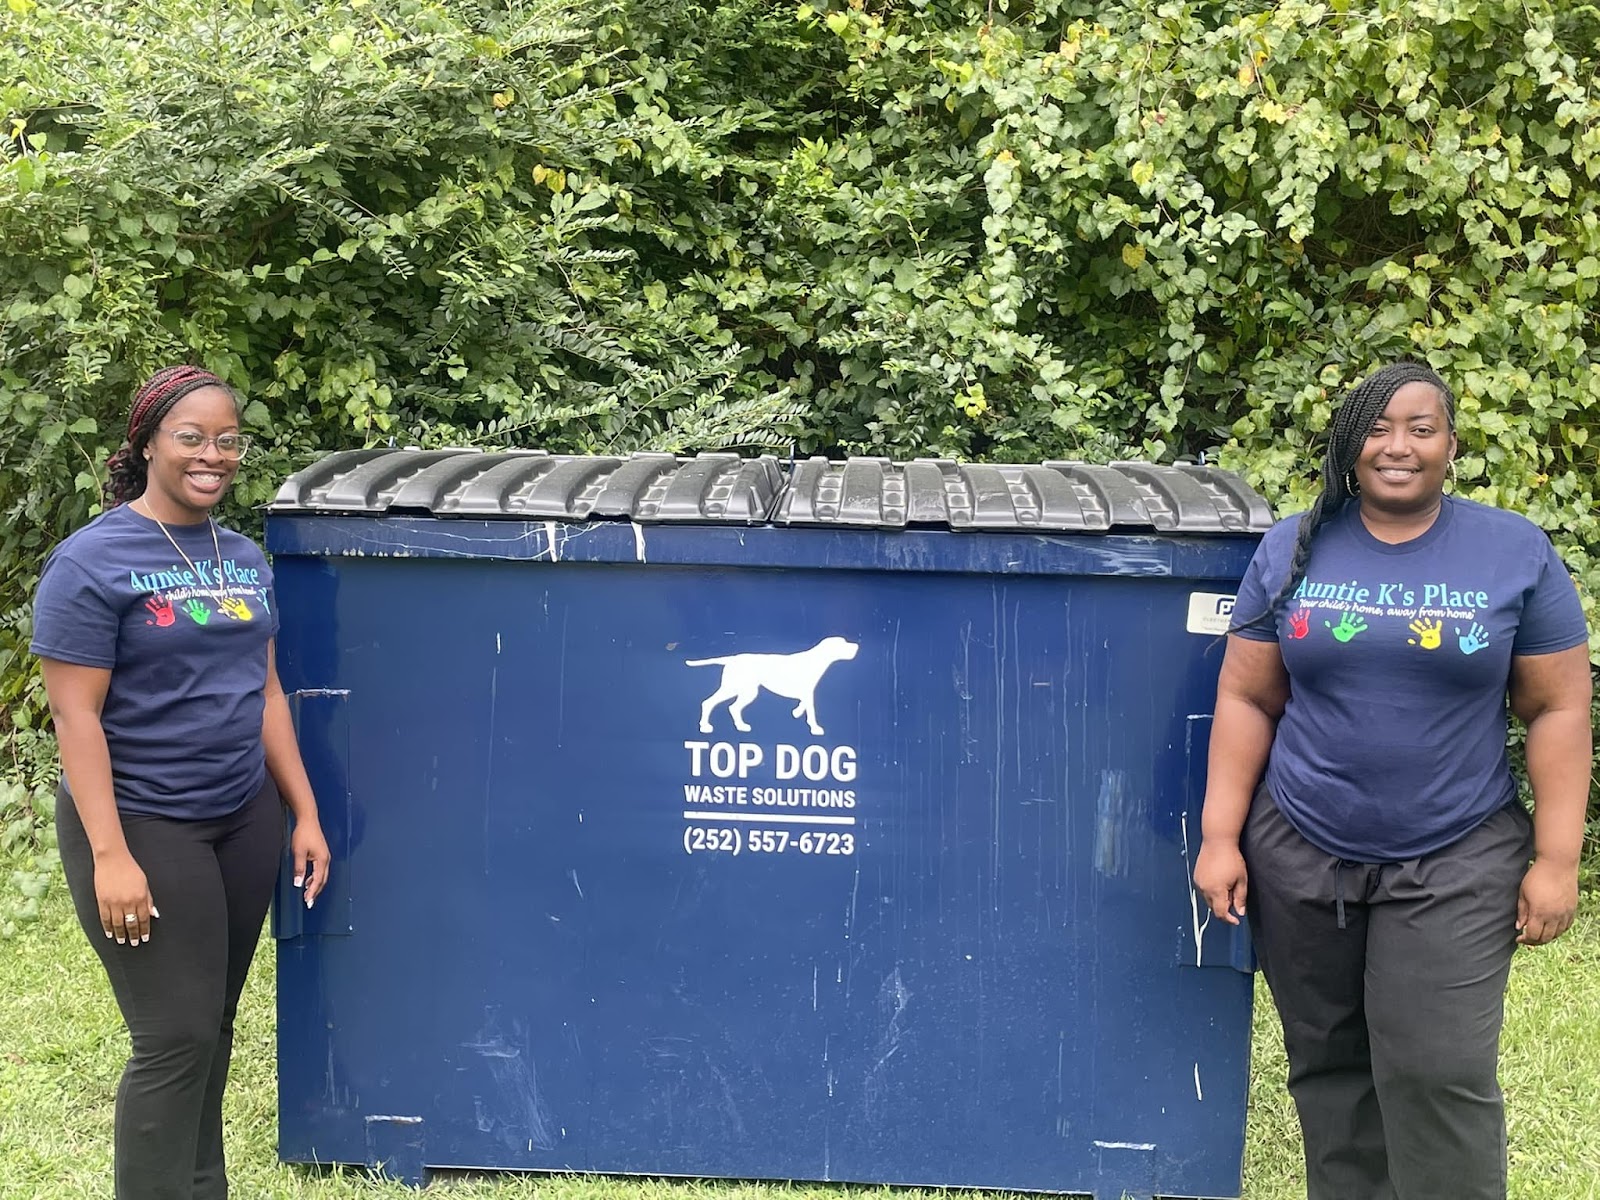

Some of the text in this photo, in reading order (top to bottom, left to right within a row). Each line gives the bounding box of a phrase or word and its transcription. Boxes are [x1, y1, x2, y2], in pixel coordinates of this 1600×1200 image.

[129, 559, 260, 592] Auntie K's Place
[1292, 576, 1489, 609] Auntie K's Place
[1318, 599, 1352, 612] child's
[1352, 602, 1384, 617] home,
[1386, 608, 1417, 620] away
[1417, 606, 1447, 619] from
[684, 741, 857, 782] TOP DOG
[684, 785, 856, 809] WASTE SOLUTIONS
[683, 826, 855, 857] (252) 557-6723
